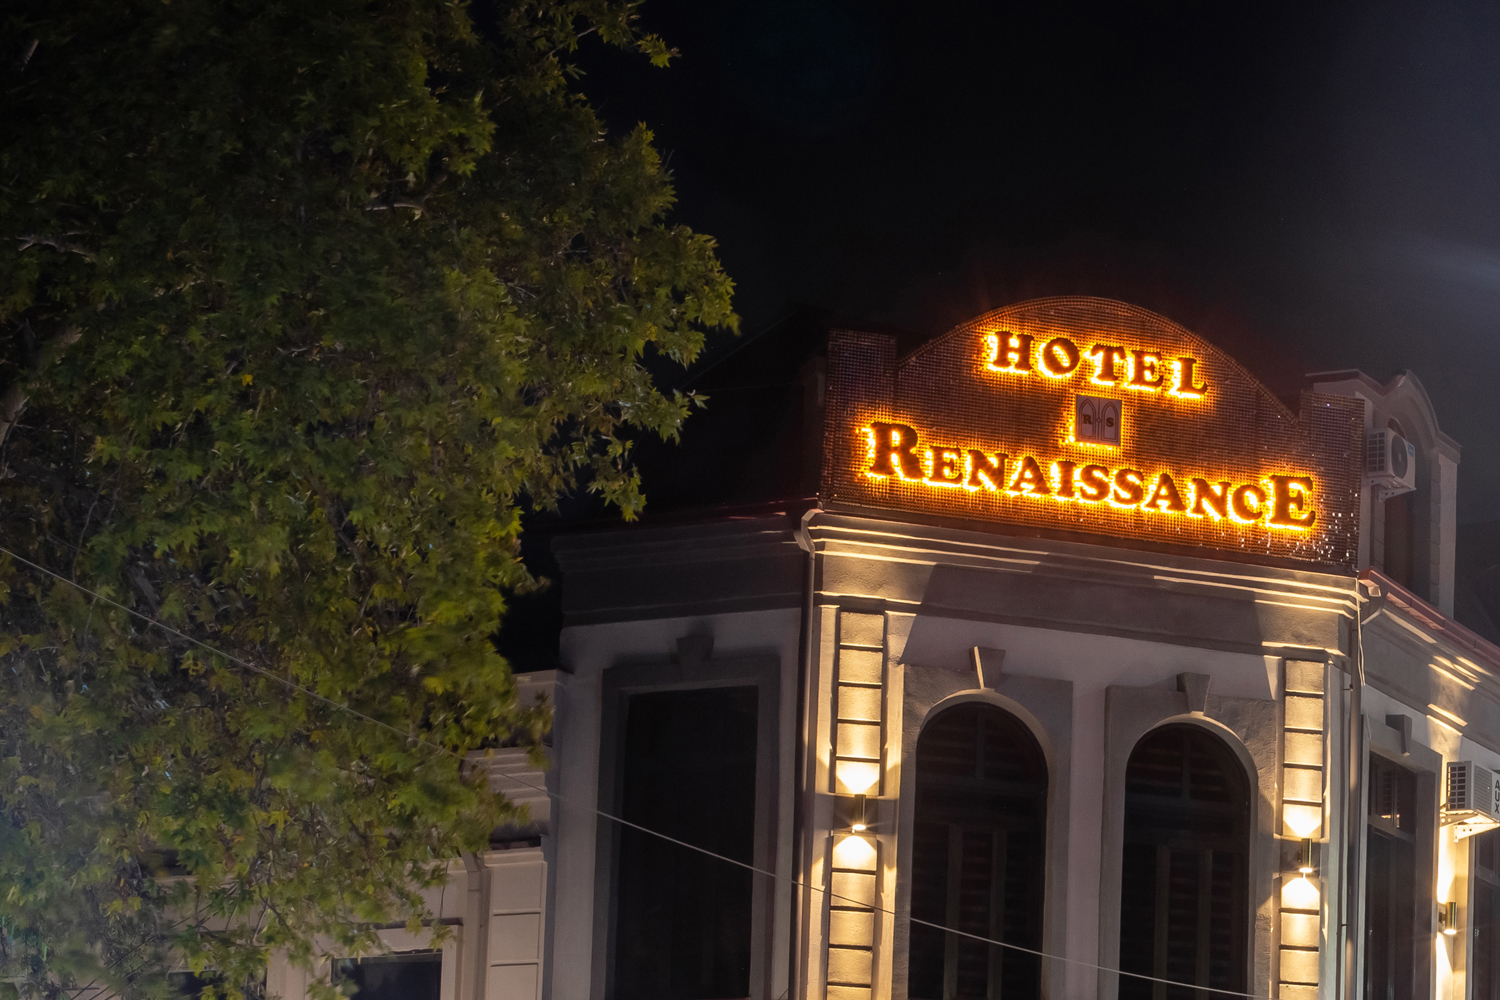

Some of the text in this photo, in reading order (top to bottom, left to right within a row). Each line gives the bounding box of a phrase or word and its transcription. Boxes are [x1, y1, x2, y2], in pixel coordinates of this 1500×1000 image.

[989, 330, 1208, 397] HOTEL
[1082, 414, 1115, 428] R S
[866, 420, 1316, 528] RENAISSANCE
